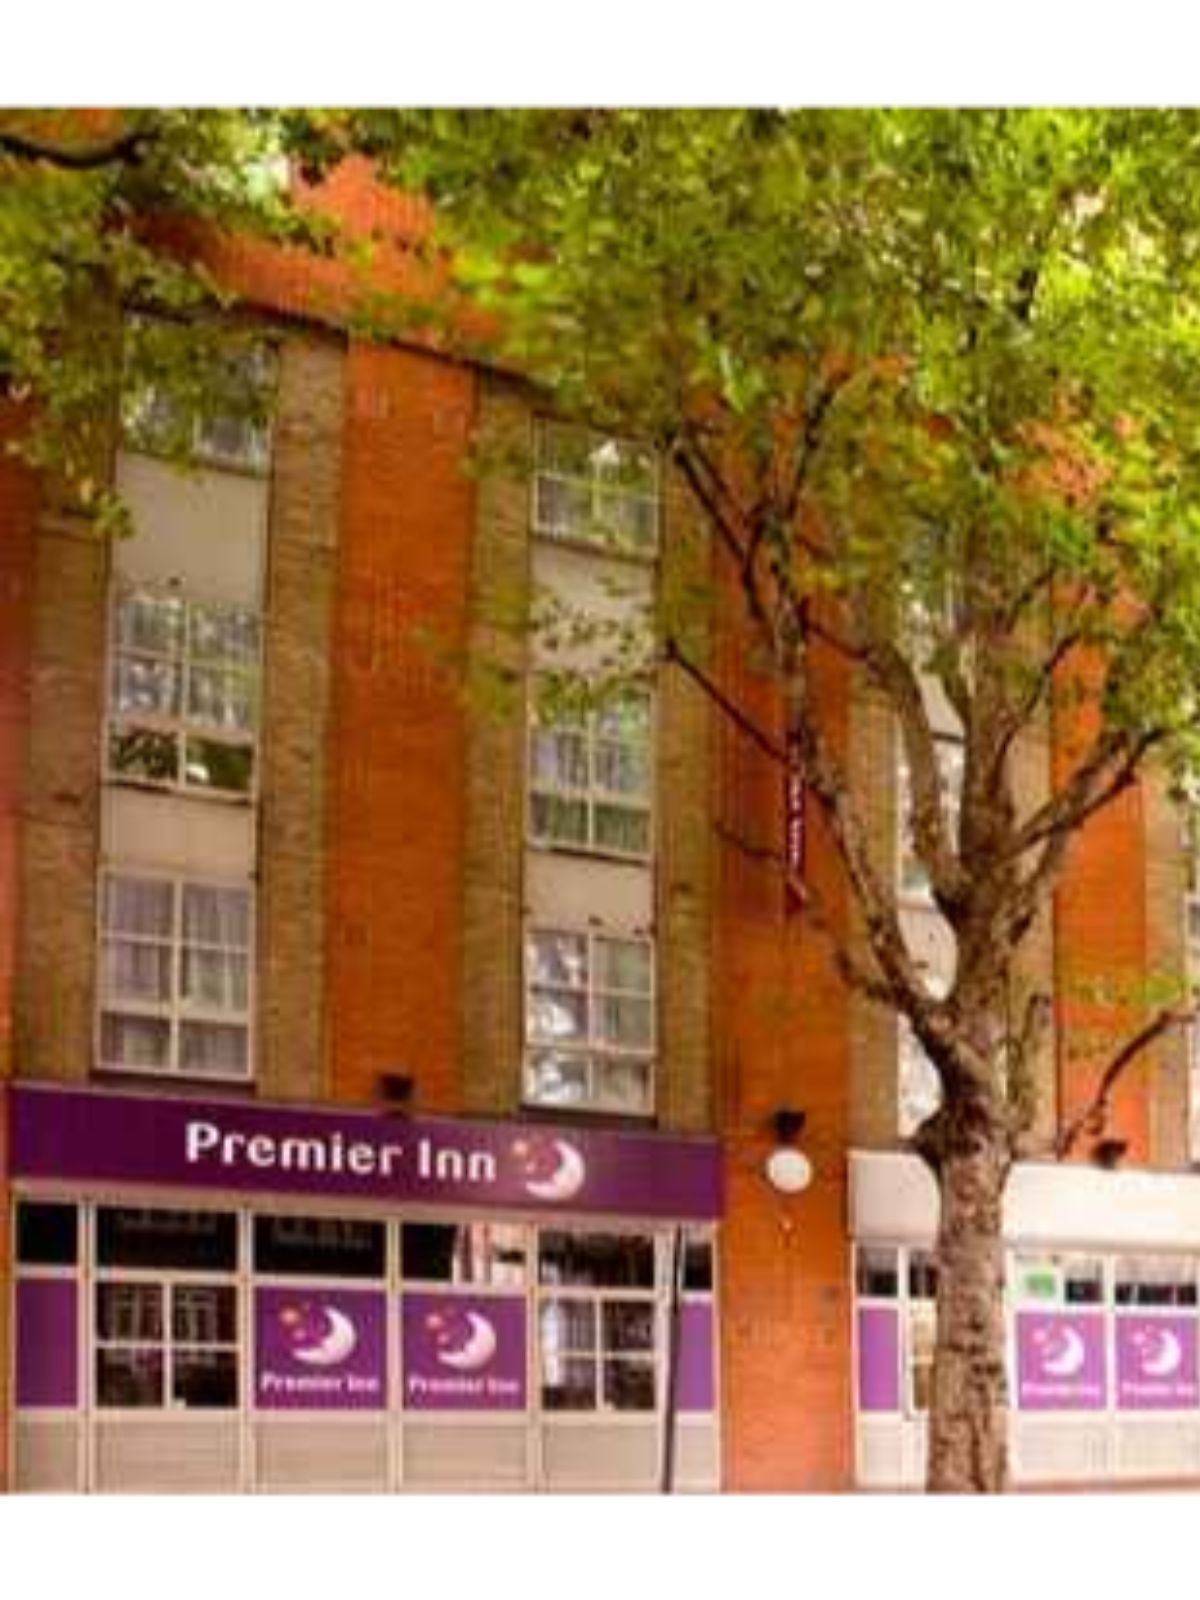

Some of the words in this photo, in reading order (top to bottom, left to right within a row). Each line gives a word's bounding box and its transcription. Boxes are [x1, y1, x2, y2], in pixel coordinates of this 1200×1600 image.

[186, 1121, 403, 1175] Premier
[418, 1137, 497, 1182] Inn
[261, 1371, 341, 1393] Premier
